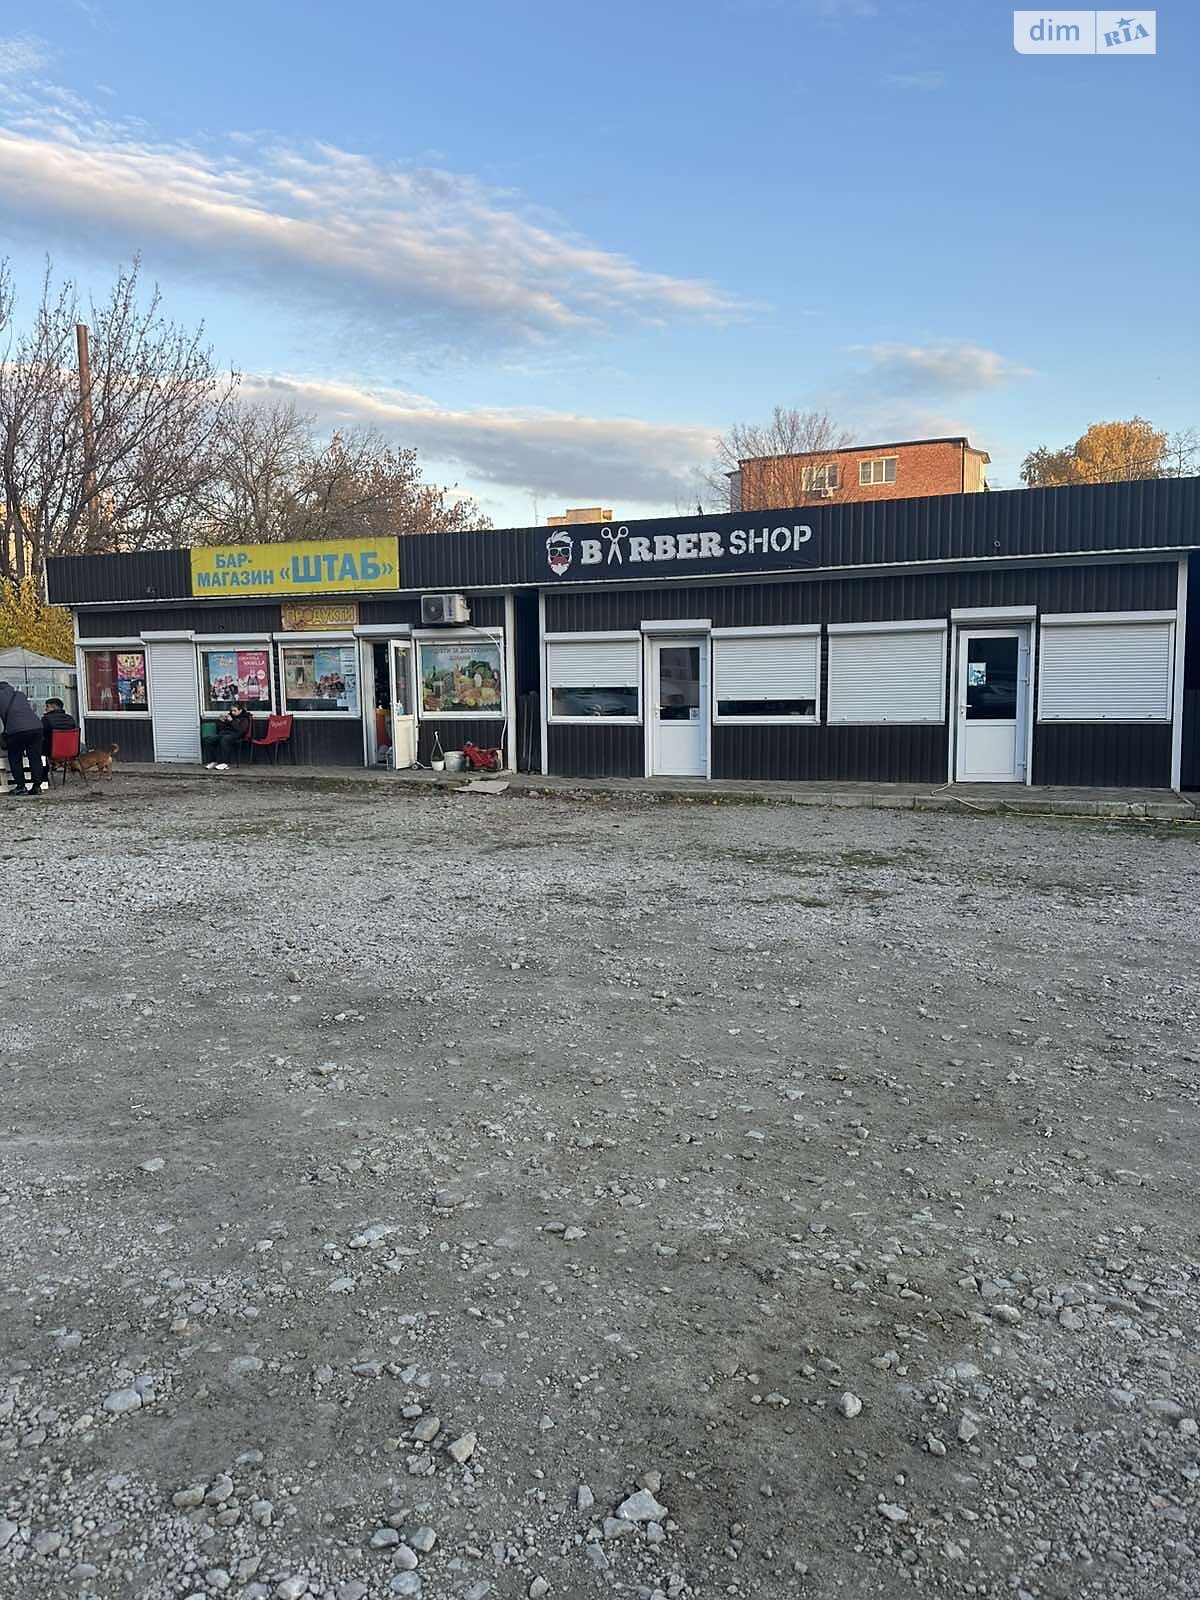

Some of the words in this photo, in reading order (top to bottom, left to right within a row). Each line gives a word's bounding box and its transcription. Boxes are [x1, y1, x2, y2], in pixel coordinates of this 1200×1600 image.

[729, 525, 812, 554] SHOP
[215, 552, 253, 569] БАР-
[280, 551, 394, 584] «ШТАБ»
[197, 570, 274, 587] МАГАЗИН
[286, 606, 354, 623] ПРОДУКТИ
